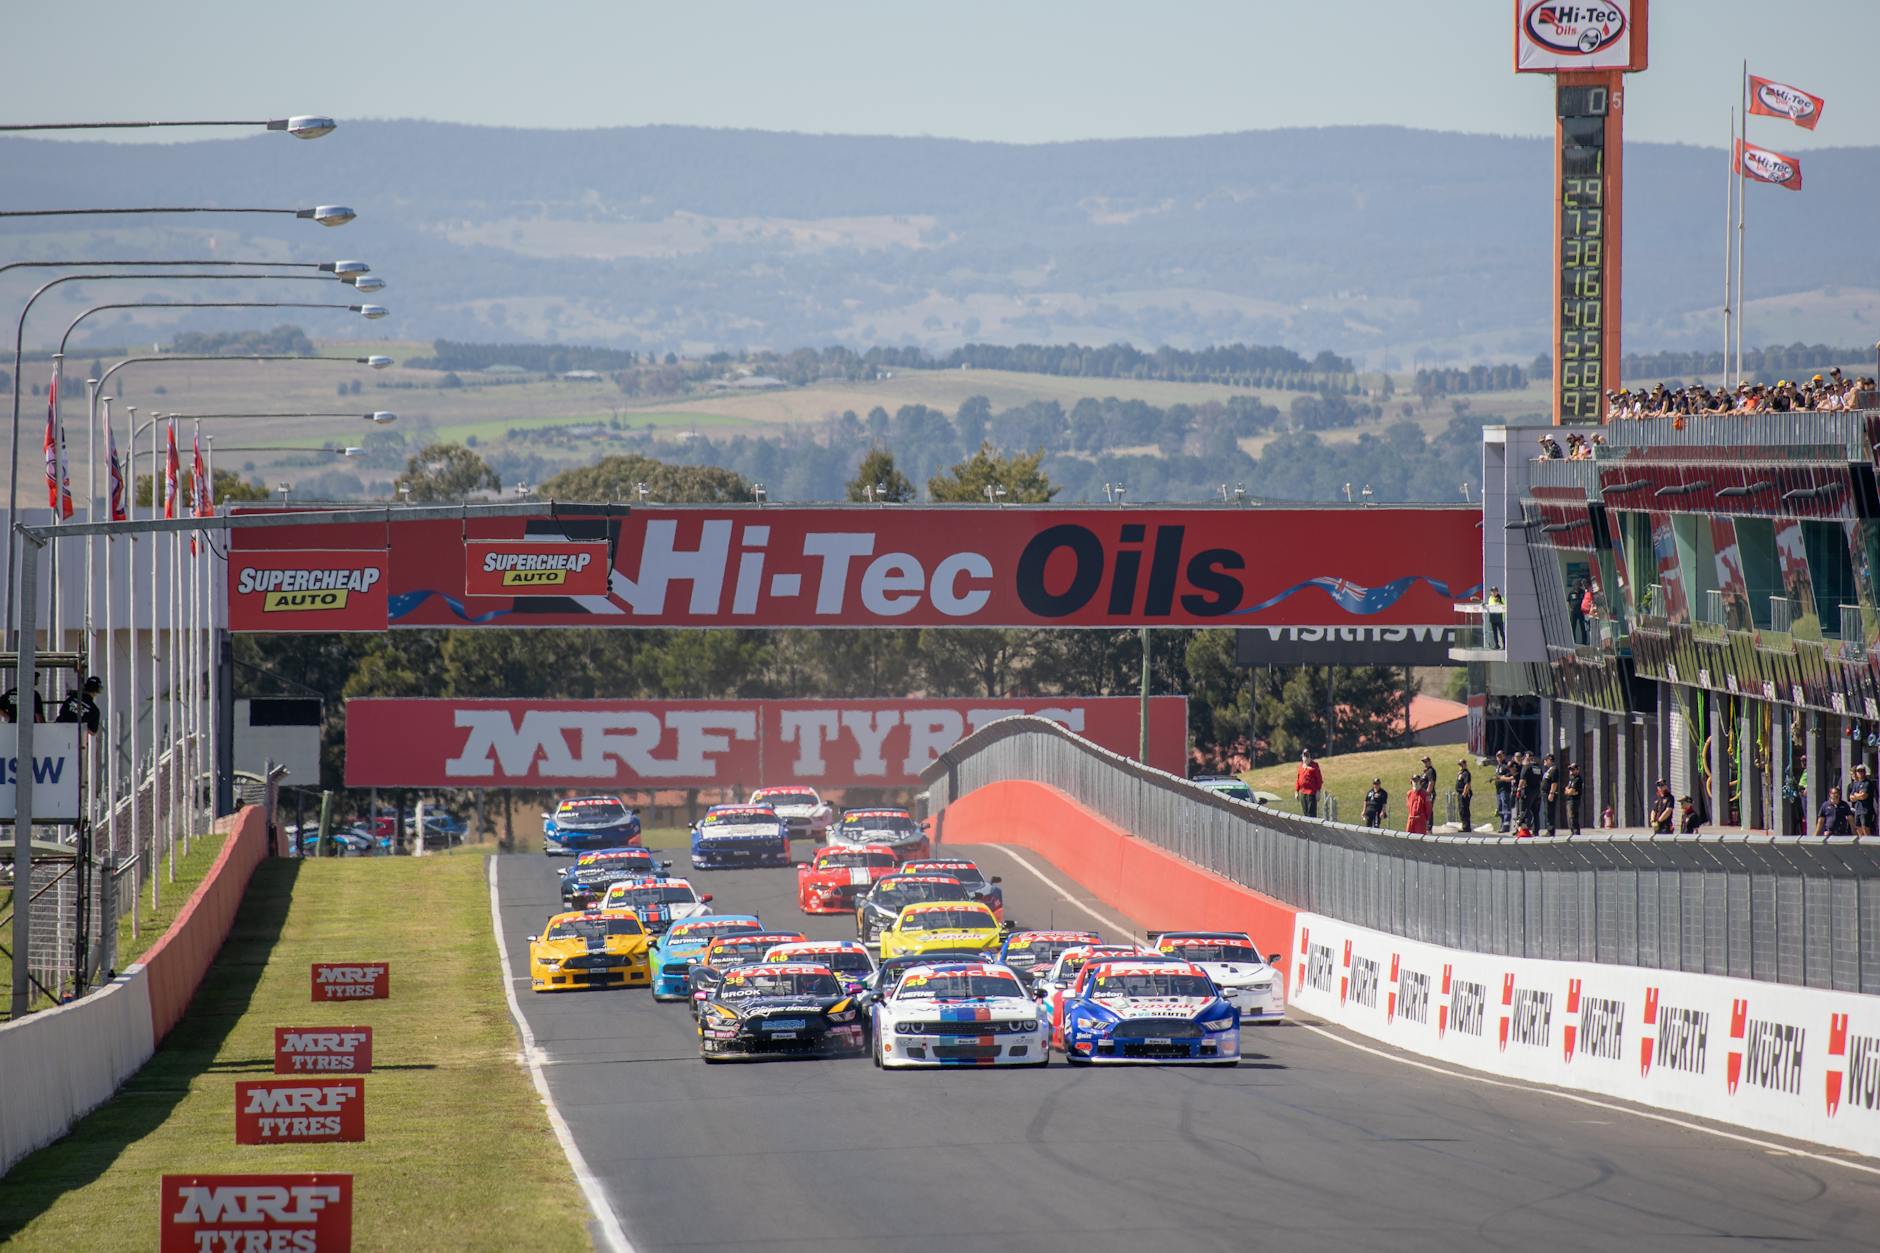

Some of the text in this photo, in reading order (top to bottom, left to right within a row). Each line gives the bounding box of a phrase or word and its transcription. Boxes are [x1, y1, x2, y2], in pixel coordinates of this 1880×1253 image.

[1557, 6, 1618, 24] Hi-Tec
[1555, 25, 1577, 36] Oils
[1776, 88, 1812, 108] Hi-Tec
[1756, 155, 1791, 174] Hi-Tec
[1564, 179, 1601, 206] 29
[1567, 209, 1601, 236] 73
[1565, 240, 1601, 267] 38
[1575, 270, 1600, 297] 16
[1563, 300, 1600, 328] 40
[1563, 330, 1600, 358] 55
[1563, 361, 1600, 388] 68
[1563, 391, 1600, 417] 93
[484, 551, 591, 573] SUPERCHEAP
[632, 517, 1246, 618] Hi-Tec Oils
[238, 566, 380, 595] SUPERCHEAP
[510, 572, 558, 583] AUTO
[274, 593, 338, 608] AUTO
[445, 708, 1085, 778] MRF TYR
[724, 935, 793, 945] PAYCE
[316, 967, 385, 983] MRF
[725, 976, 745, 985] 38
[739, 967, 815, 978] PAYCE
[1096, 976, 1106, 987] 1
[324, 985, 375, 997] TYRES
[720, 989, 761, 999] BROOK
[1093, 991, 1124, 999] Seton
[281, 1033, 366, 1053] MRF
[291, 1055, 355, 1070] TYRES
[244, 1086, 357, 1114] MRF
[258, 1116, 342, 1137] TYRES
[173, 1186, 341, 1224] MRF
[194, 1229, 317, 1253] TYRES
